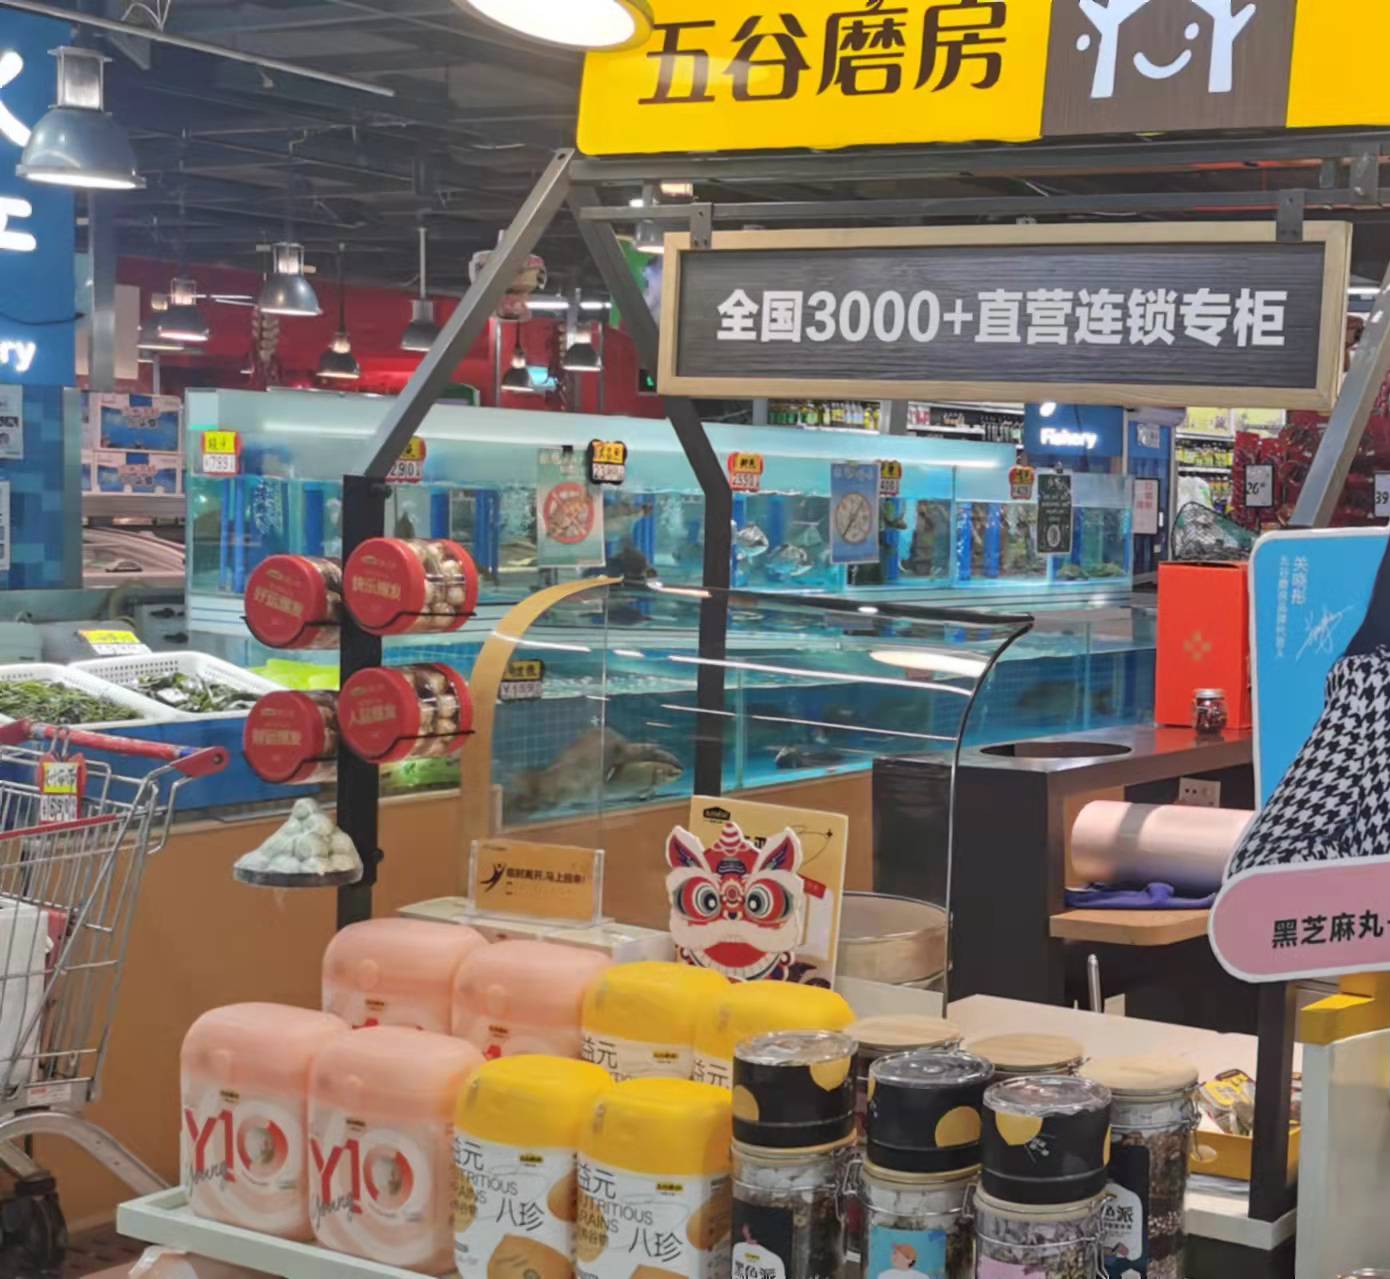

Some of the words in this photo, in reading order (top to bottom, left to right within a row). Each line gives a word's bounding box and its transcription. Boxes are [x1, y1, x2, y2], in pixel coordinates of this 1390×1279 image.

[638, 0, 1007, 105] 五谷磨房
[716, 288, 1288, 347] 全国3000+直营连锁专柜
[1040, 427, 1098, 449] Fishery
[496, 1198, 545, 1232] 八珍
[628, 1228, 683, 1263] 八珍
